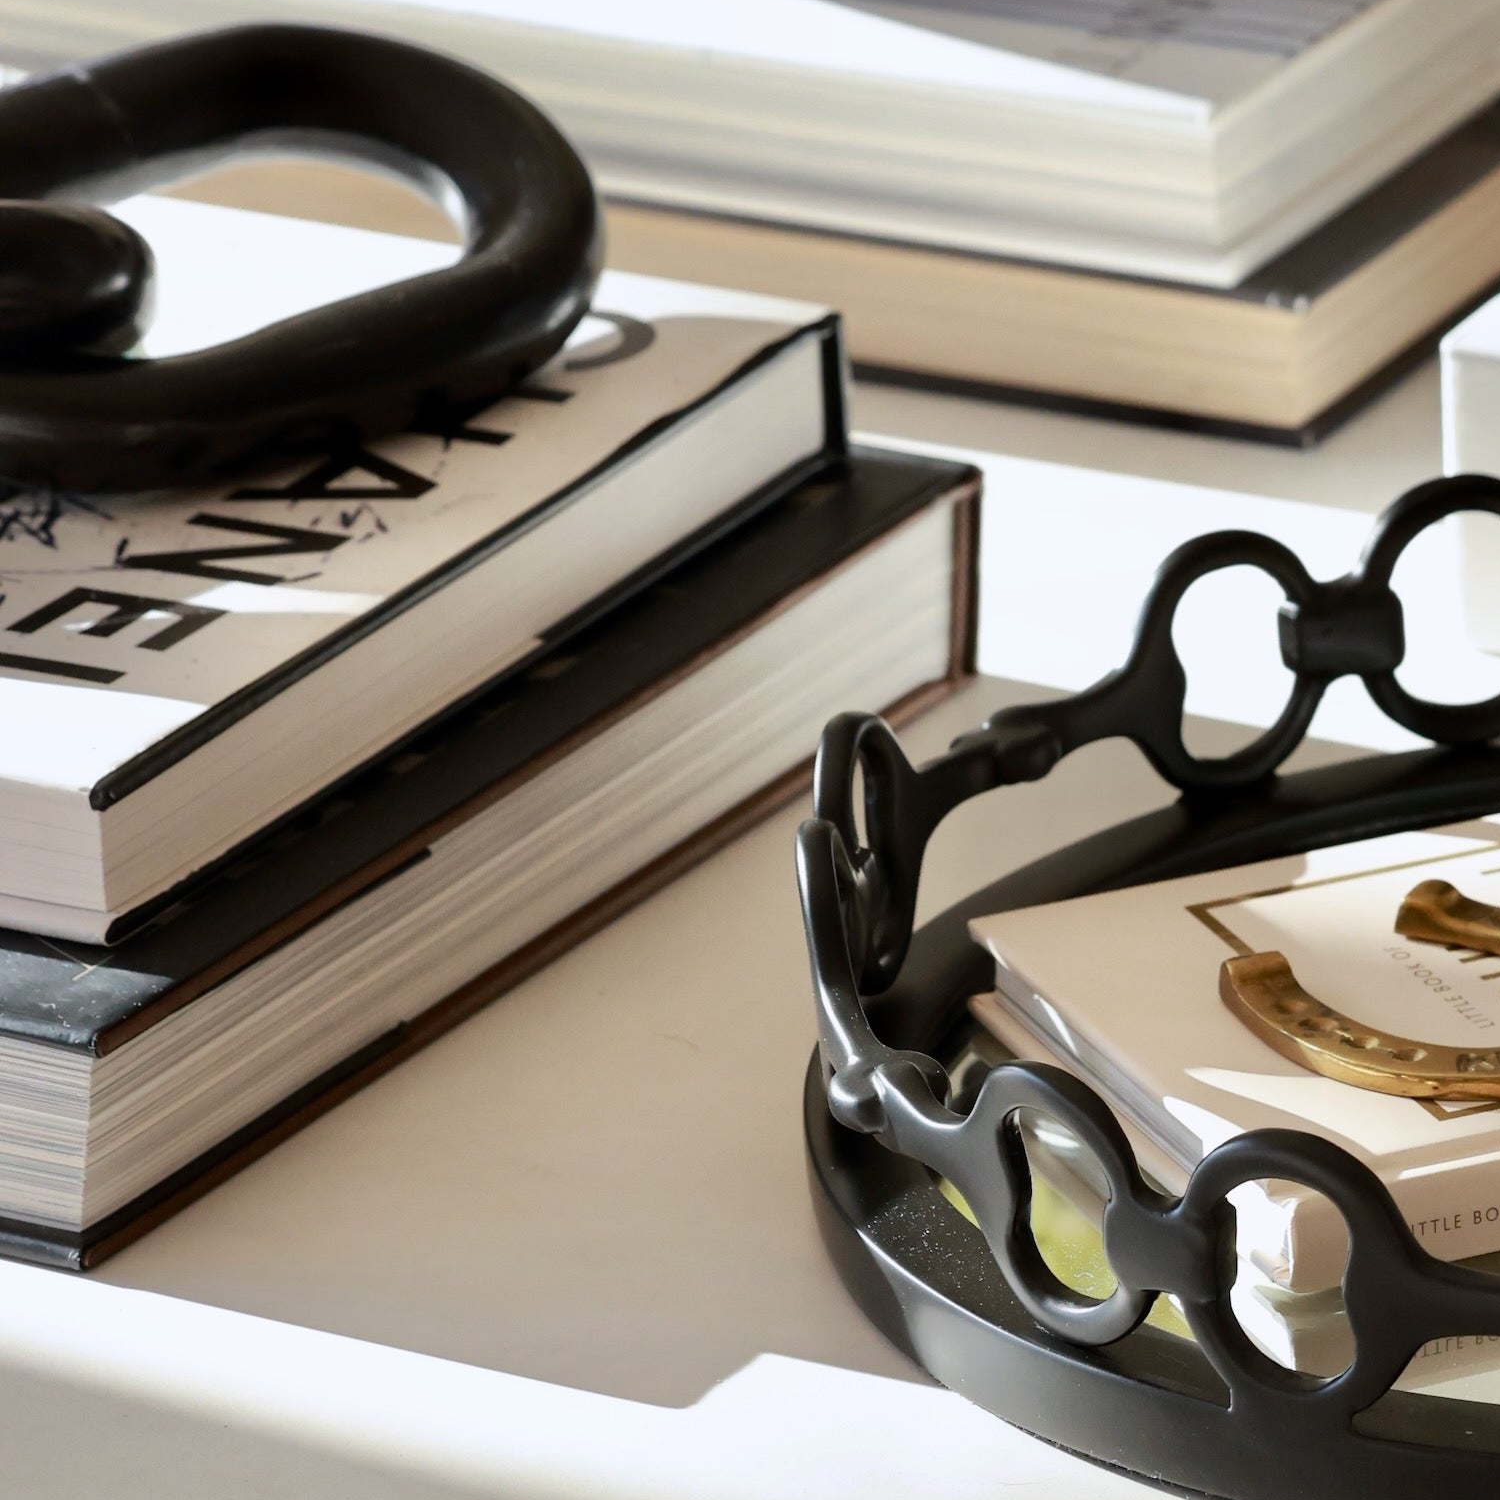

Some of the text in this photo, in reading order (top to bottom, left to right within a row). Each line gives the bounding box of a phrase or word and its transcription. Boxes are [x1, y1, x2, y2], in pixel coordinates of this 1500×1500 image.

[1384, 947, 1495, 1029] LITTLE BOOK OF
[1411, 1214, 1462, 1237] ITTLE
